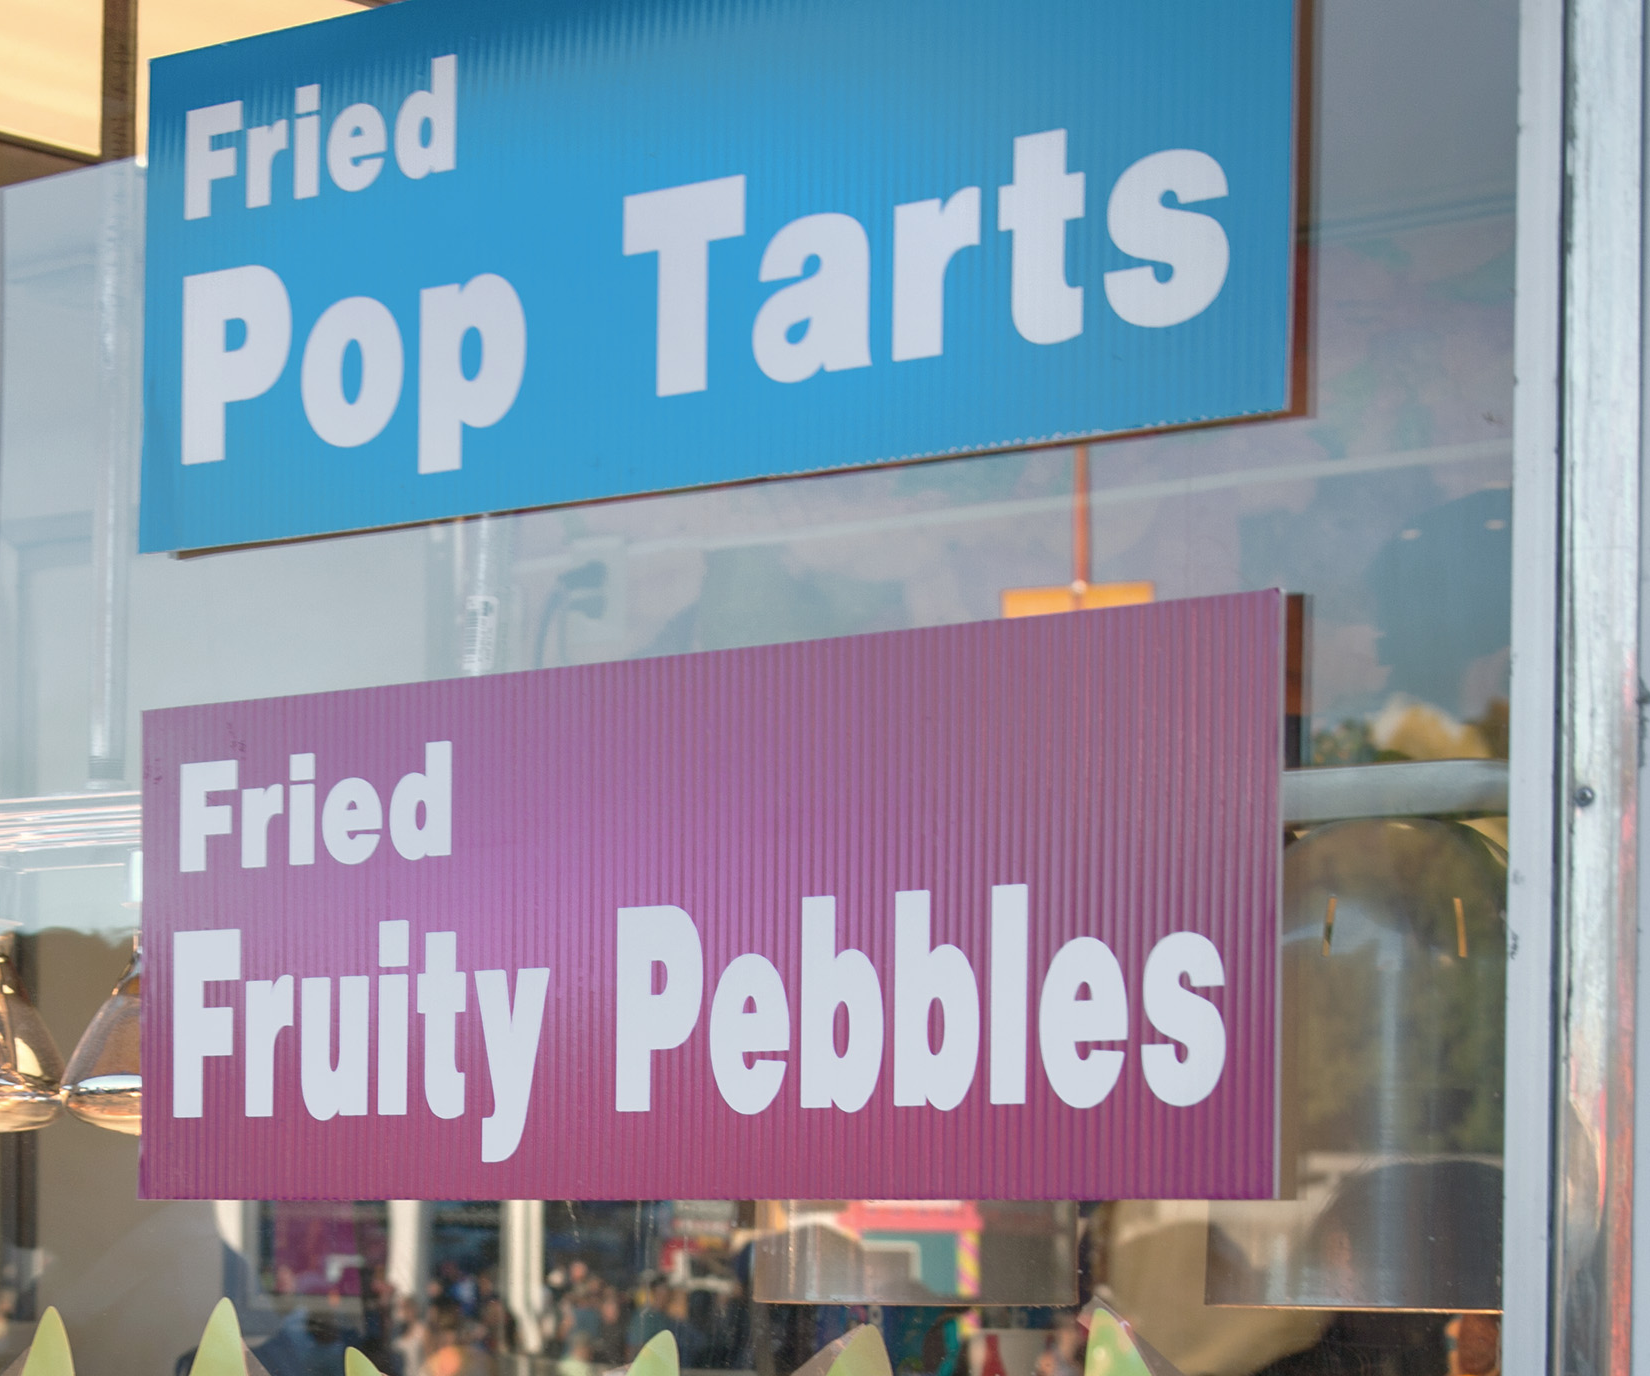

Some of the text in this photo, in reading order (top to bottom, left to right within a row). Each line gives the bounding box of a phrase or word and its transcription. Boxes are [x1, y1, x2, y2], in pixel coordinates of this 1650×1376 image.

[182, 54, 457, 220] Fried
[181, 128, 1230, 475] Pop Tarts
[179, 740, 454, 873] Fried
[172, 883, 1227, 1164] Fruity Pebbles
